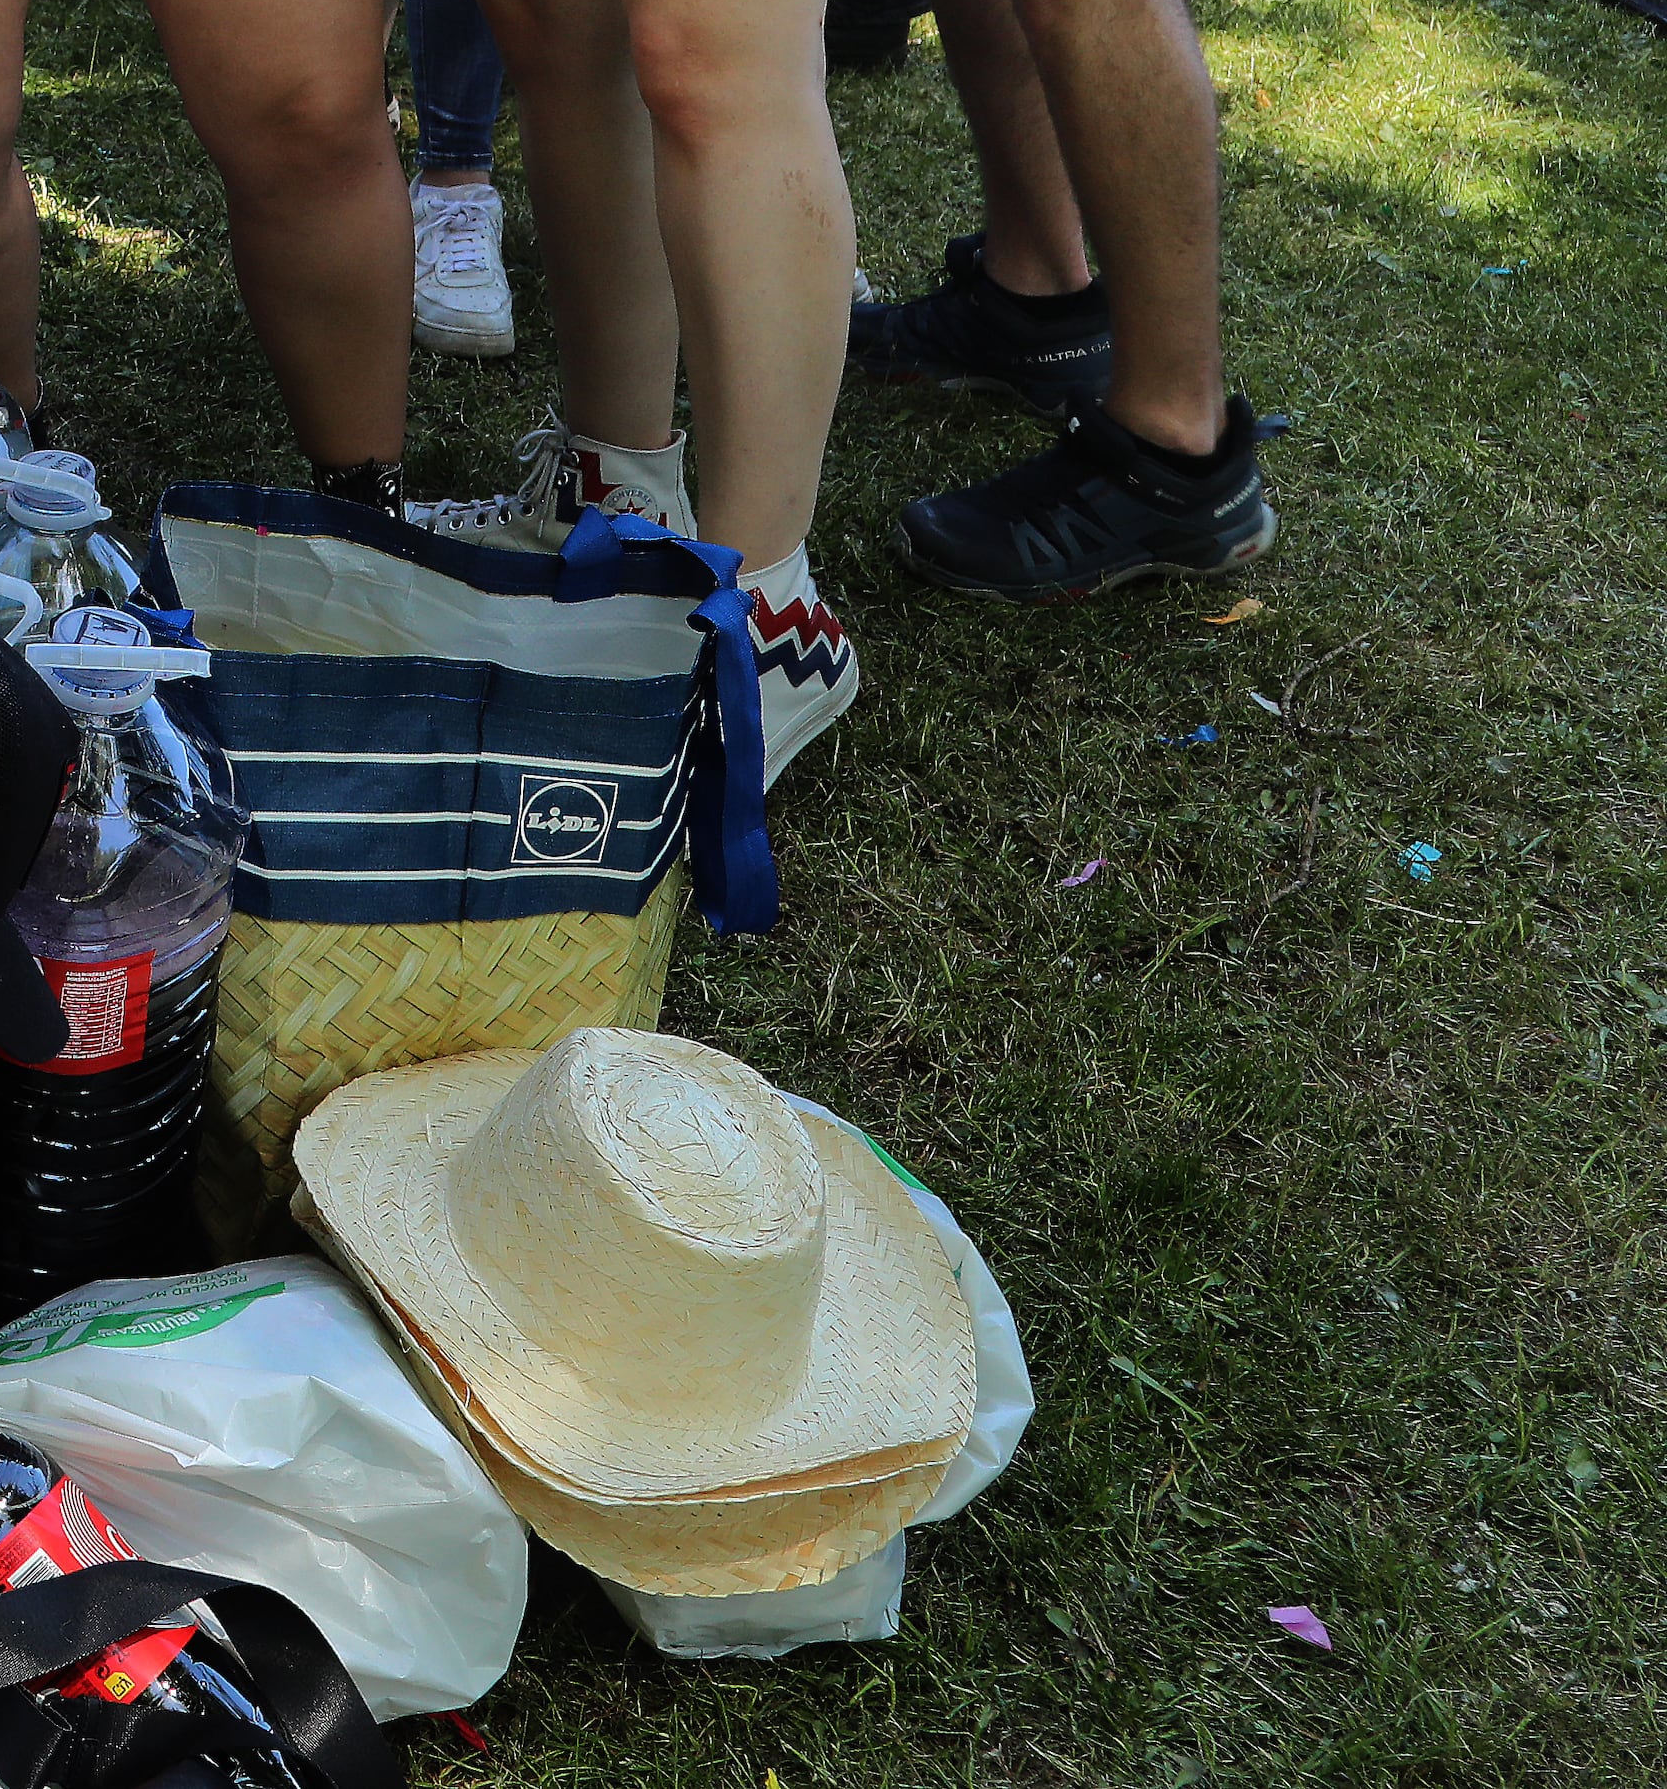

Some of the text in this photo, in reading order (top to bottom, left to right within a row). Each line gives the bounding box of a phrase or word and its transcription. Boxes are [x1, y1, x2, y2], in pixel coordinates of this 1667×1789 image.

[1038, 347, 1088, 364] ULTRA
[605, 487, 653, 510] CONVERSE
[171, 1275, 249, 1297] RECYCLED
